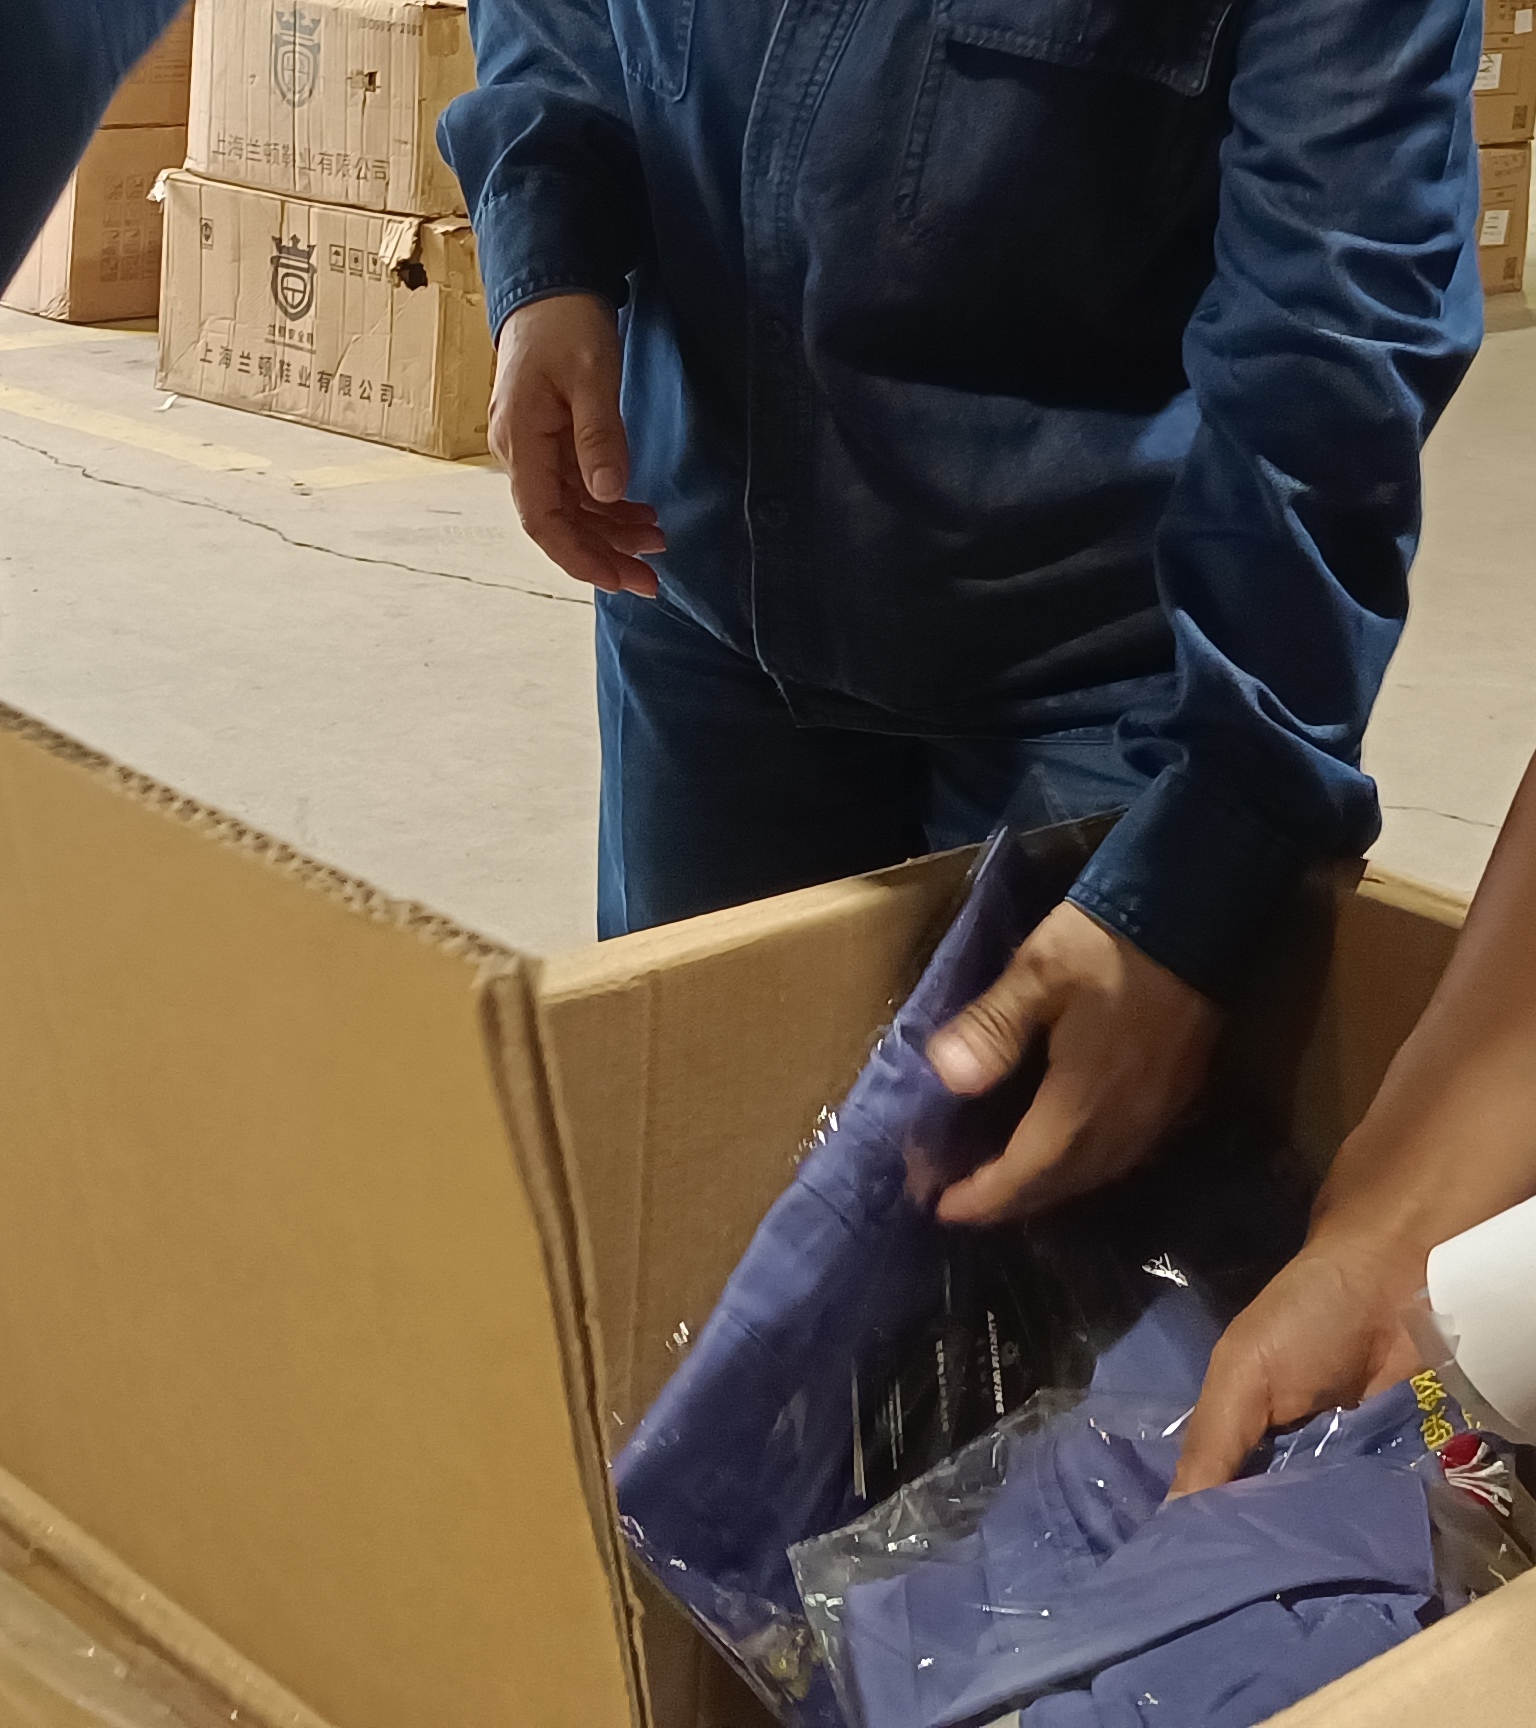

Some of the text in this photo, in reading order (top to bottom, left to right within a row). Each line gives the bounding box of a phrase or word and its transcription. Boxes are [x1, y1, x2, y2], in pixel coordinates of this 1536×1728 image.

[199, 341, 395, 408] 上海兰顿鞋业有限公司
